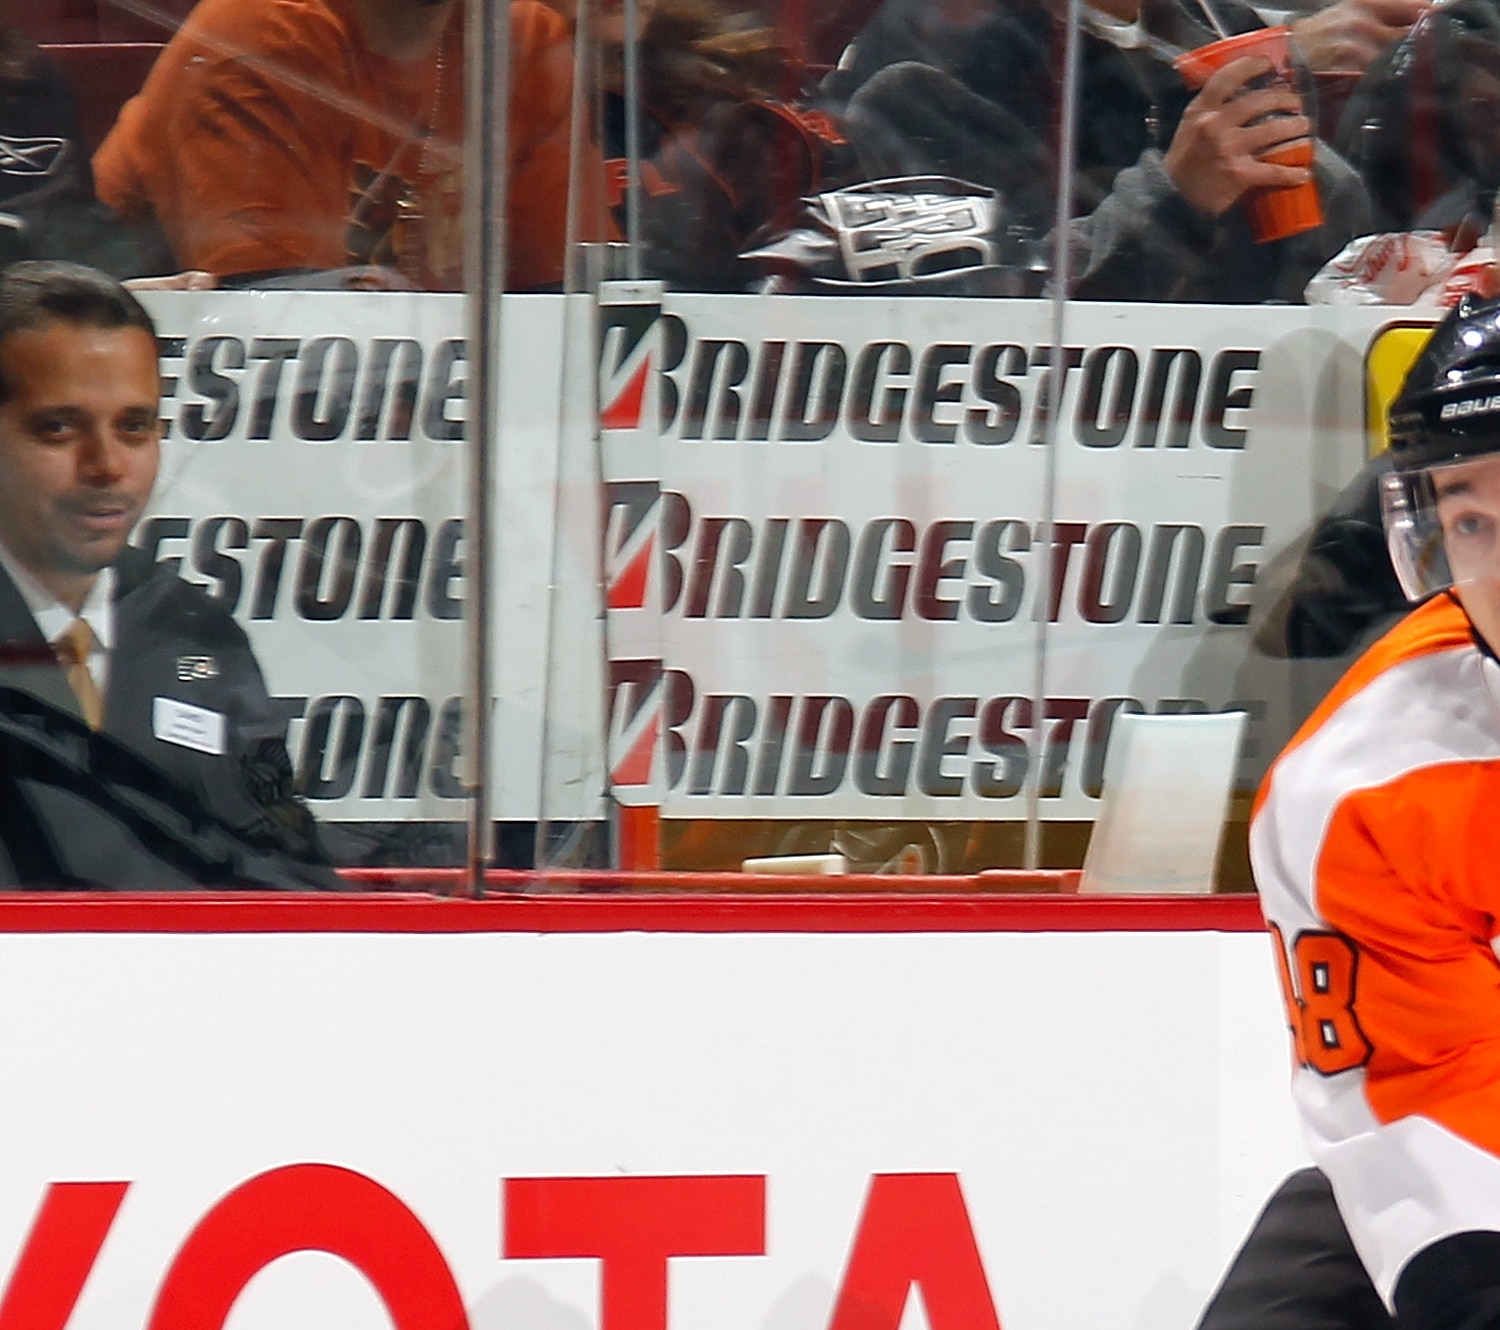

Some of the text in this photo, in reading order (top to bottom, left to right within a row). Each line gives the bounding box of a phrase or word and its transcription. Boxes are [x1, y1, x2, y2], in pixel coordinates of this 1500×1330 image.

[601, 303, 1263, 450] BRIDGESTONE
[604, 481, 1267, 625] BRIDGESTONE
[608, 659, 1266, 800] BRIDGESTO
[1268, 920, 1375, 1078] 8
